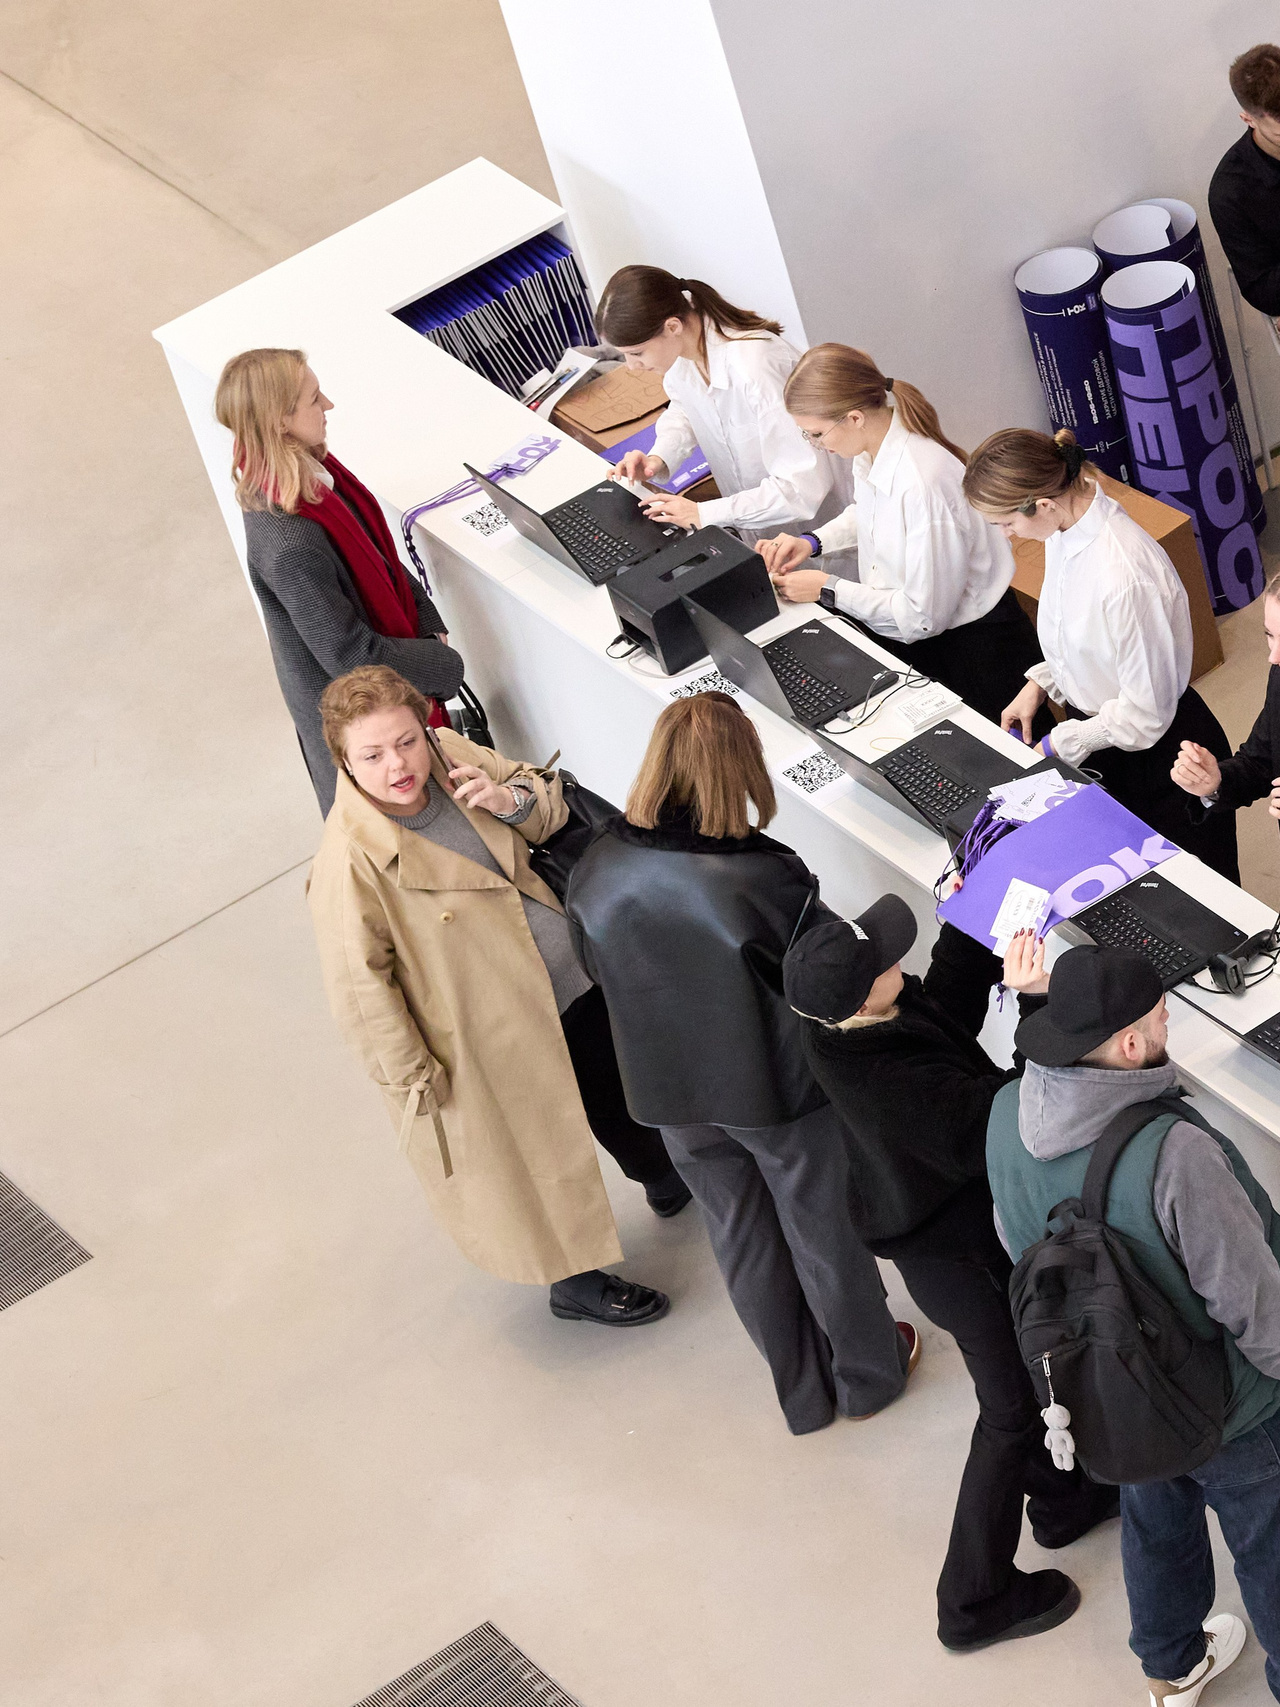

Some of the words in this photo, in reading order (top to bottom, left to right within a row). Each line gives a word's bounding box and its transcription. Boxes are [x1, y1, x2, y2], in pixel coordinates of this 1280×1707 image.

[1107, 314, 1217, 608] ПЕК
[1159, 286, 1267, 609] ПРОС
[1046, 834, 1181, 920] ОК
[1139, 881, 1160, 890] ThinkPad
